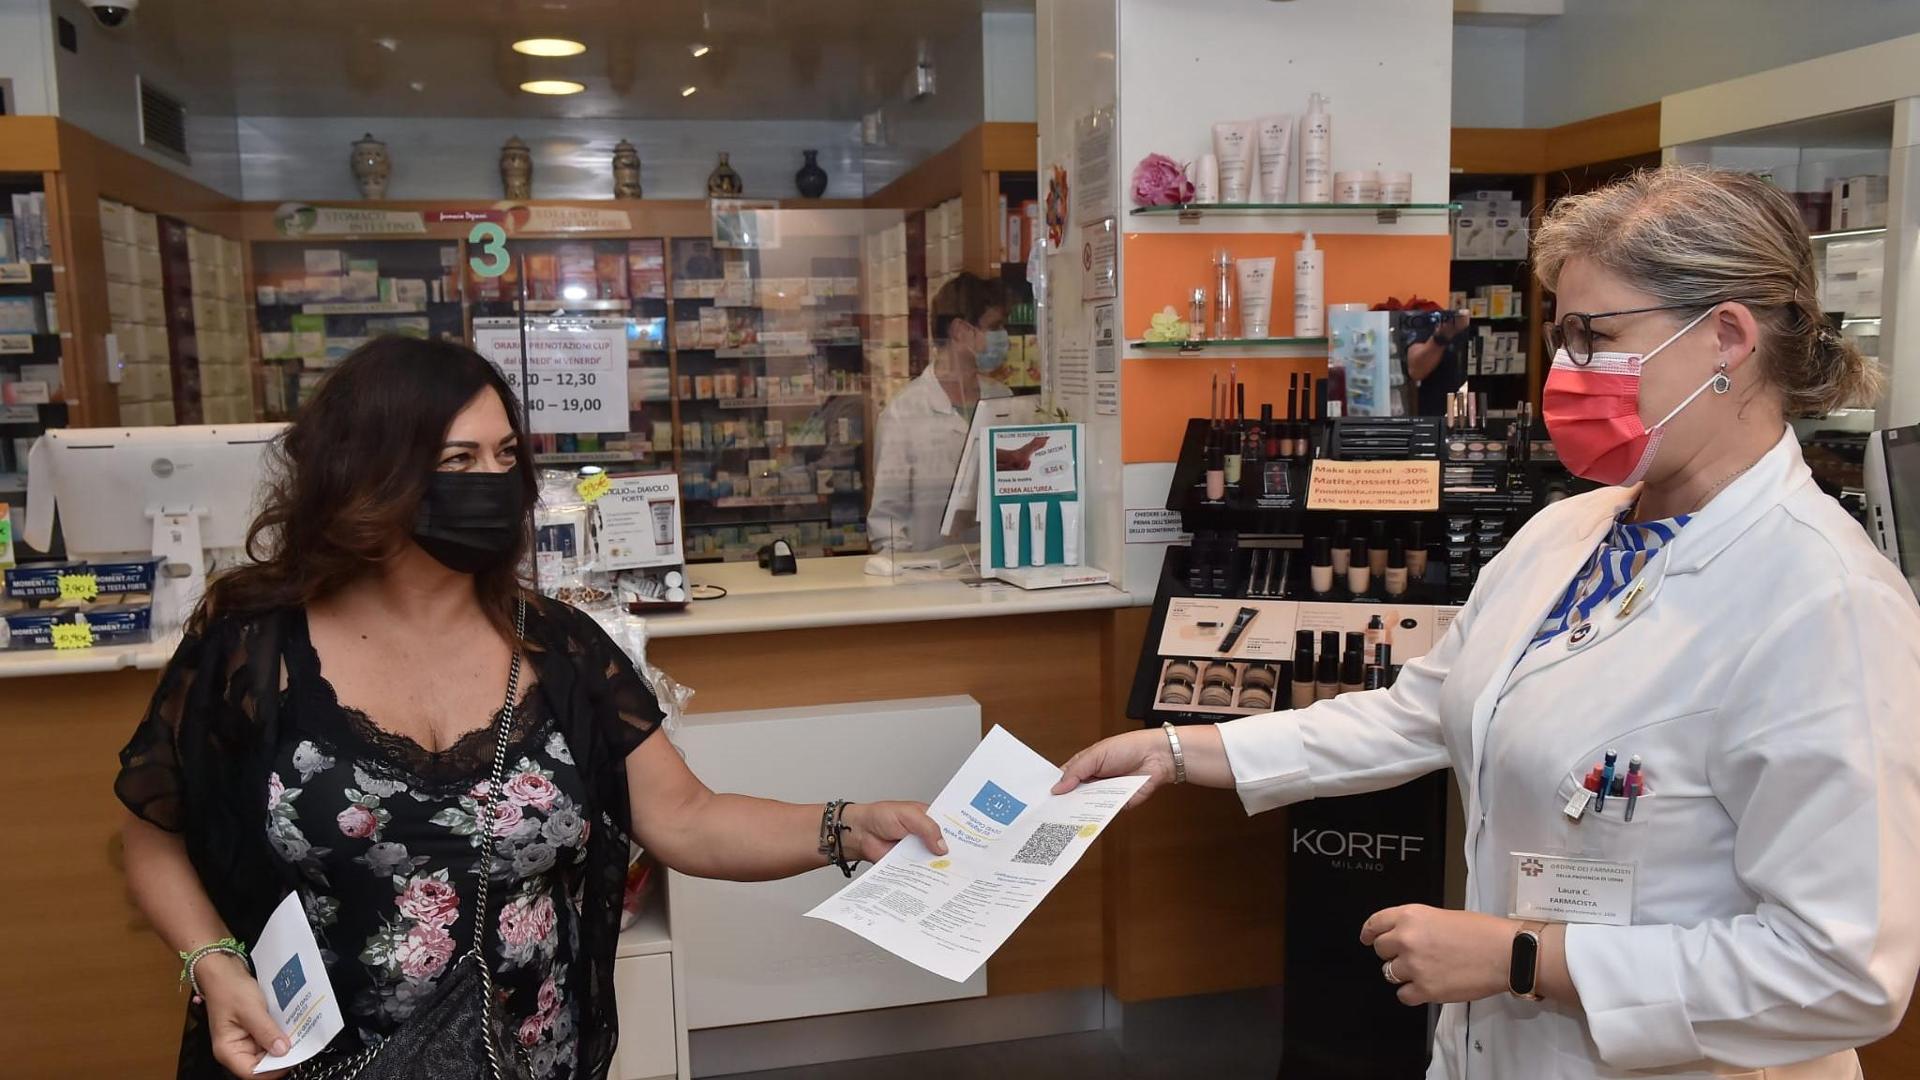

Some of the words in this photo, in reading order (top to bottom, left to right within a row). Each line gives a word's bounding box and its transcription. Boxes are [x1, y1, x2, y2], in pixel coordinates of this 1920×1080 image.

[469, 222, 511, 277] 3
[529, 341, 591, 350] PRENOTAZIONI
[593, 342, 610, 350] CUP
[503, 357, 517, 365] dal
[556, 373, 596, 388] 12,30
[562, 398, 602, 413] 19,00
[1315, 466, 1345, 474] Make
[637, 485, 670, 494] DIAVOLO
[998, 487, 1022, 495] CREMA
[621, 495, 645, 503] FORTE
[107, 584, 127, 592] TESTA
[1292, 828, 1425, 861] KORFF
[1331, 859, 1385, 872] MILANO
[1558, 886, 1581, 895] Laura
[1582, 888, 1591, 896] C.
[1549, 897, 1598, 908] FARMACISTA
